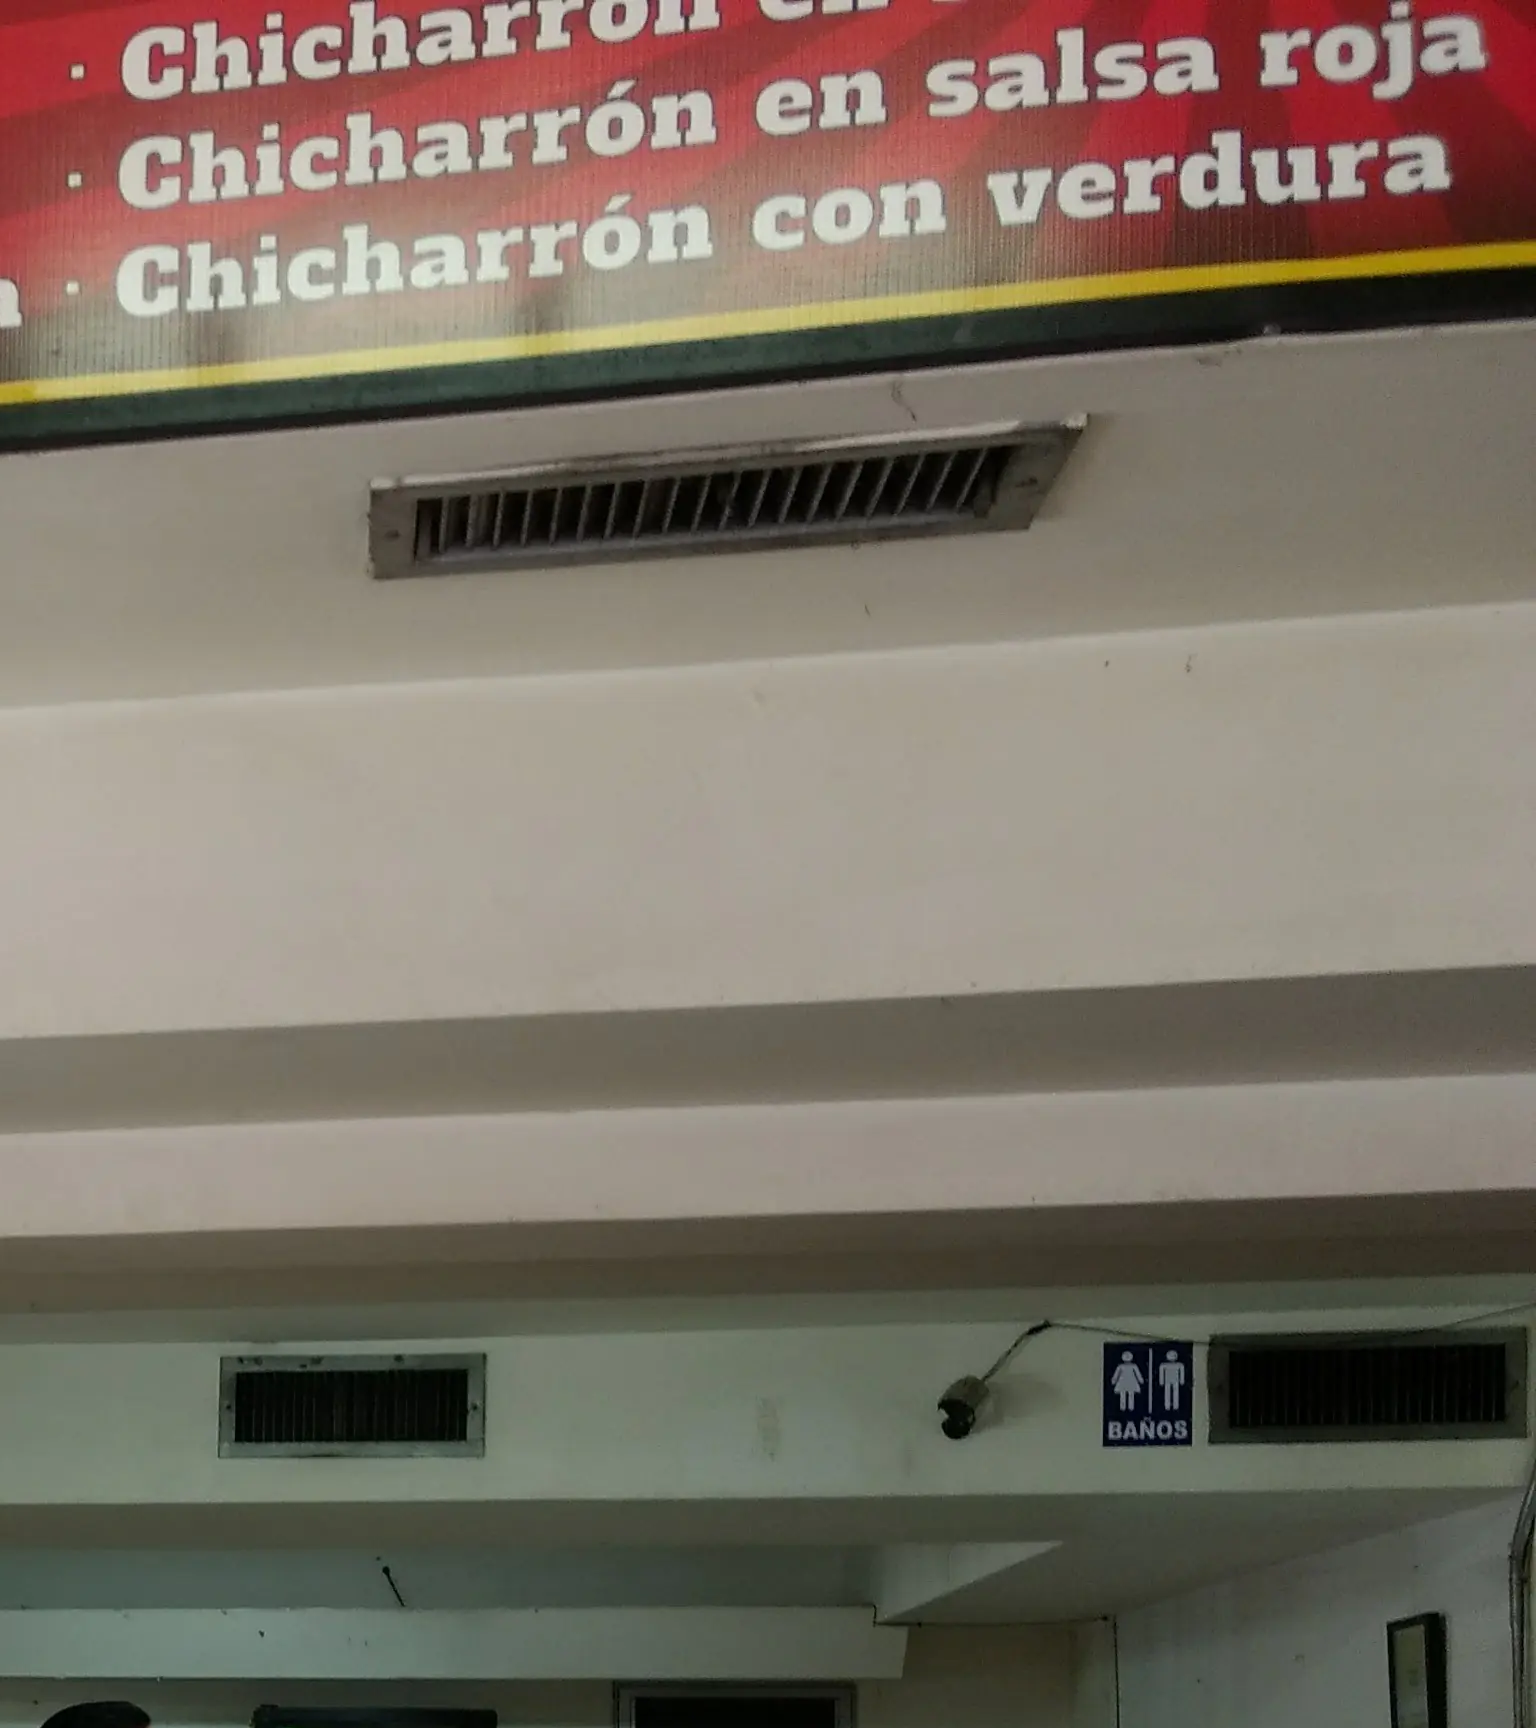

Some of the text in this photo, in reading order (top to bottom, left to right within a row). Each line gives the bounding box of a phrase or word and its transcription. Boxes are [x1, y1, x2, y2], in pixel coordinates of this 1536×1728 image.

[118, 1, 1489, 210] Chicharrón en salsa roja
[116, 130, 1453, 318] Chicharrón con verdura
[1108, 1417, 1188, 1441] BAÑOS
